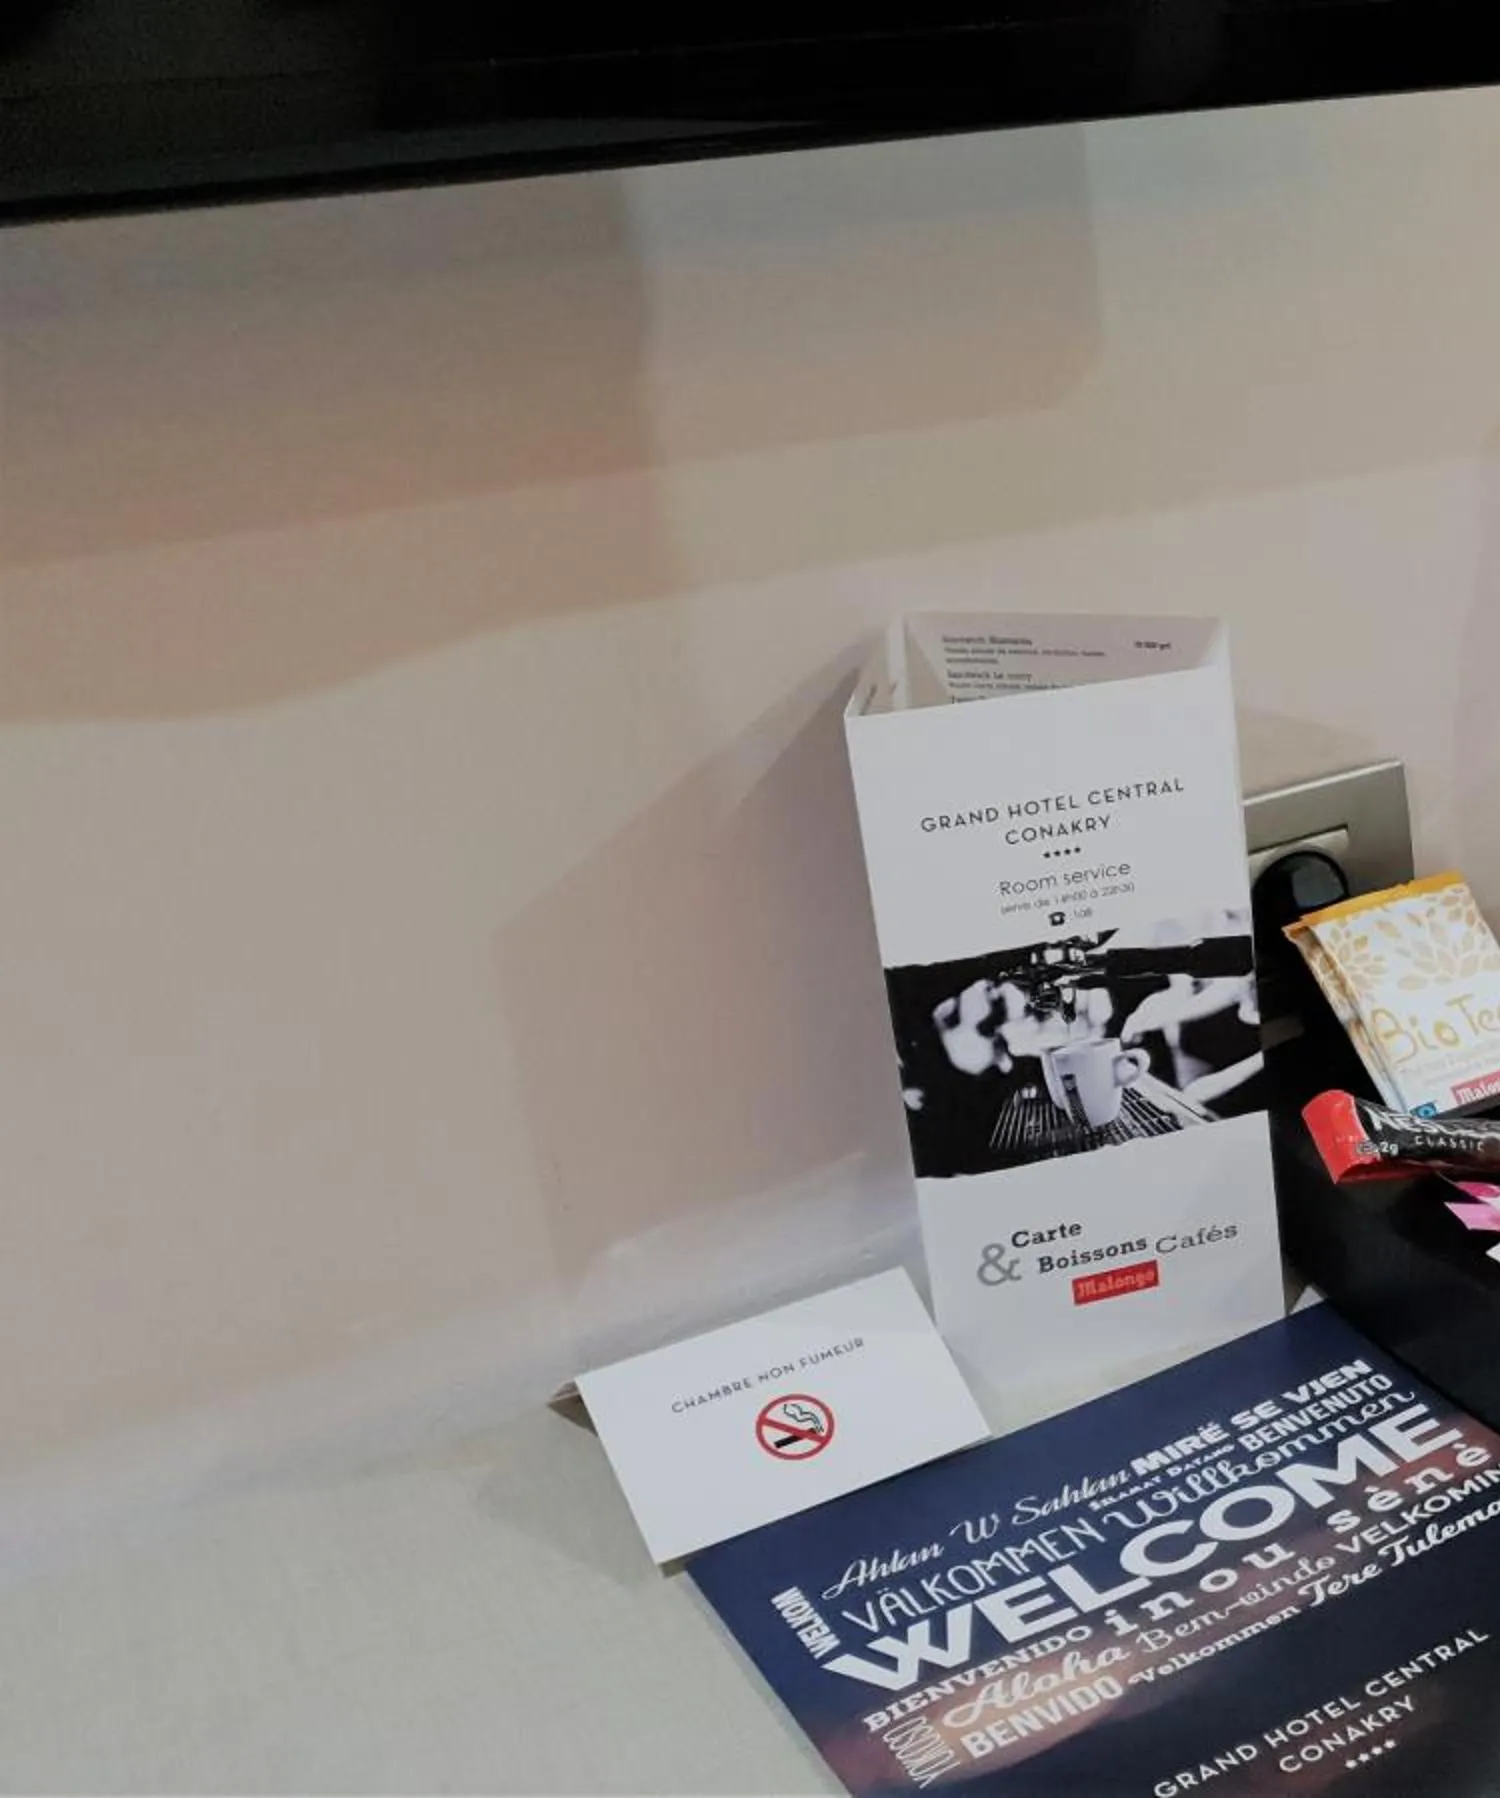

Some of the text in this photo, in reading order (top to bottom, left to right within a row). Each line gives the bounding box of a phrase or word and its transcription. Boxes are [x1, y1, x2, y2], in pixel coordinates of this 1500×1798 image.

[921, 777, 1184, 833] GRAND HOTEL CENTRAL
[1005, 815, 1111, 845] CONAKRY
[1000, 863, 1131, 896] Room service
[1415, 1135, 1485, 1151] CLASSIC
[1011, 1223, 1082, 1249] Carte
[1038, 1223, 1238, 1274] Boissons Cafés
[1077, 1269, 1155, 1298] Malongo
[671, 1337, 865, 1413] CHAMBRE NON FUMEUR
[1237, 1374, 1393, 1452] BENVENUTO
[821, 1543, 944, 1599] Ahlan
[949, 1513, 1001, 1544] W
[1011, 1468, 1131, 1526] Sahlan
[1130, 1422, 1230, 1477] MIRË
[1231, 1400, 1283, 1431] SE
[842, 1391, 1416, 1634] VÄLKOMMEN Willkommen
[822, 1403, 1464, 1691] WELCOME
[862, 1625, 1093, 1732] BIENVENIDO
[942, 1645, 1132, 1729] Aloha
[1136, 1556, 1336, 1653] Bem-vindo
[960, 1674, 1124, 1759] BENVIDO
[1297, 1563, 1383, 1607] Tere
[1154, 1628, 1490, 1798] GRAND HOTEL CENTRAL
[1279, 1694, 1416, 1773] CONAKRY
